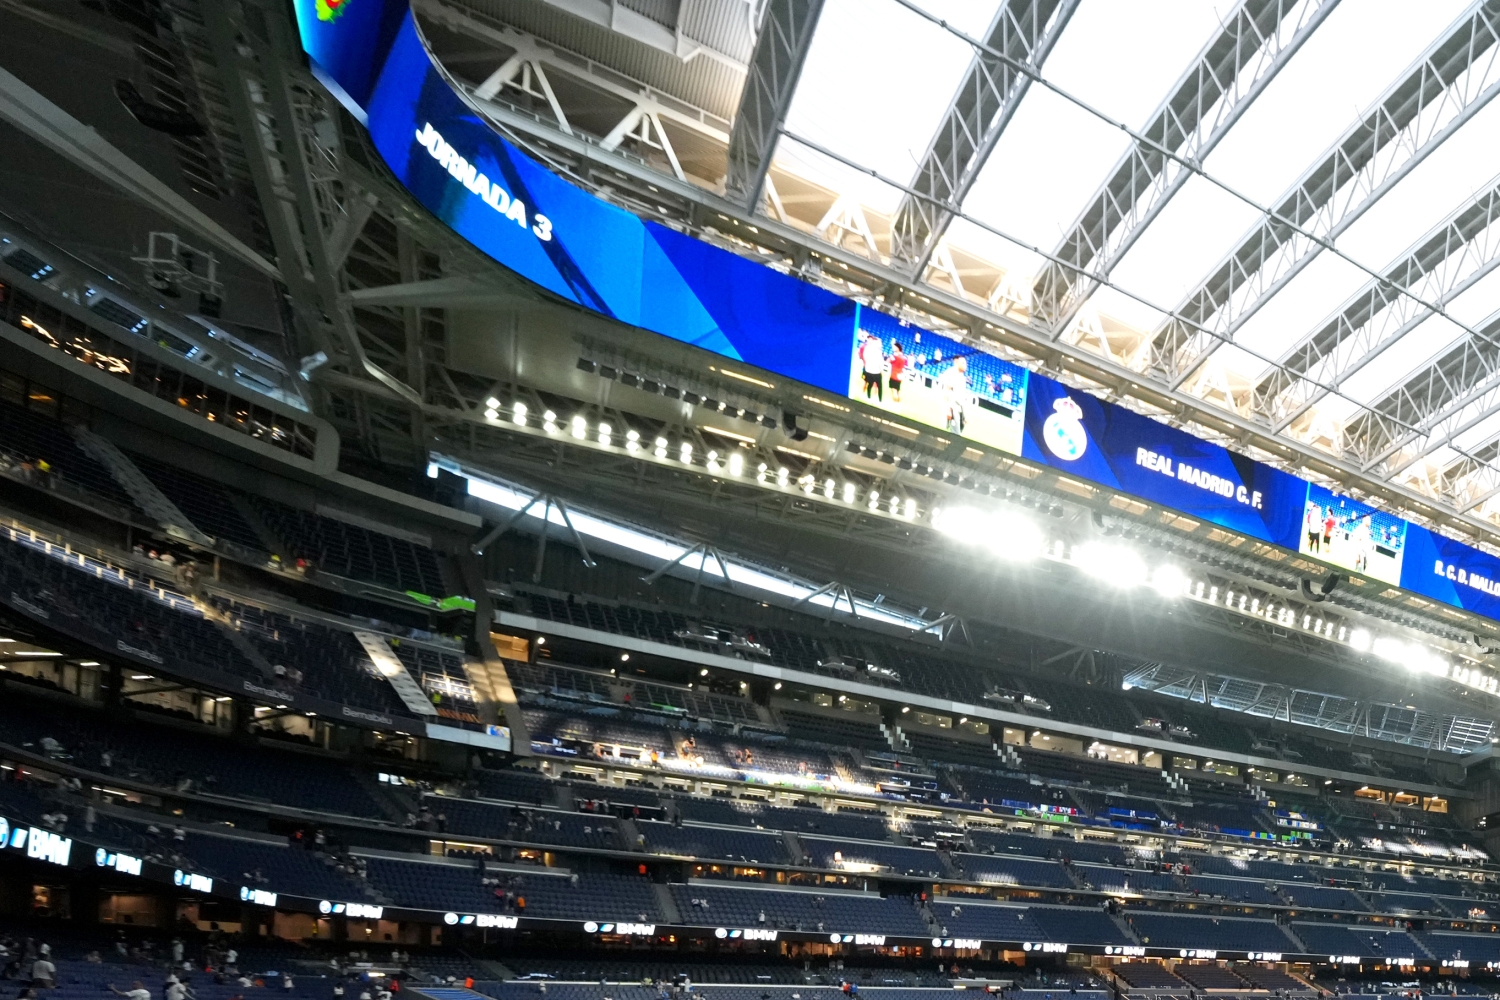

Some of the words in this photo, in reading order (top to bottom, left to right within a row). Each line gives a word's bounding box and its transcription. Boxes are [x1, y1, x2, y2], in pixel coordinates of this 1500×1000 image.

[416, 122, 527, 229] JORNADA
[533, 213, 553, 241] 3
[1136, 447, 1175, 477] REAL
[1178, 463, 1235, 498] MADRID
[1236, 485, 1250, 505] C.
[1252, 490, 1263, 510] F.
[1434, 559, 1445, 577] R.
[1446, 564, 1457, 581] C.
[1457, 568, 1468, 585] D.
[28, 827, 72, 866] BMW
[477, 914, 518, 928] BMW
[616, 923, 655, 935] BMW
[744, 930, 777, 941] BMW
[855, 934, 886, 945] BMW
[955, 939, 982, 949] BMW
[1043, 943, 1067, 953] BMW
